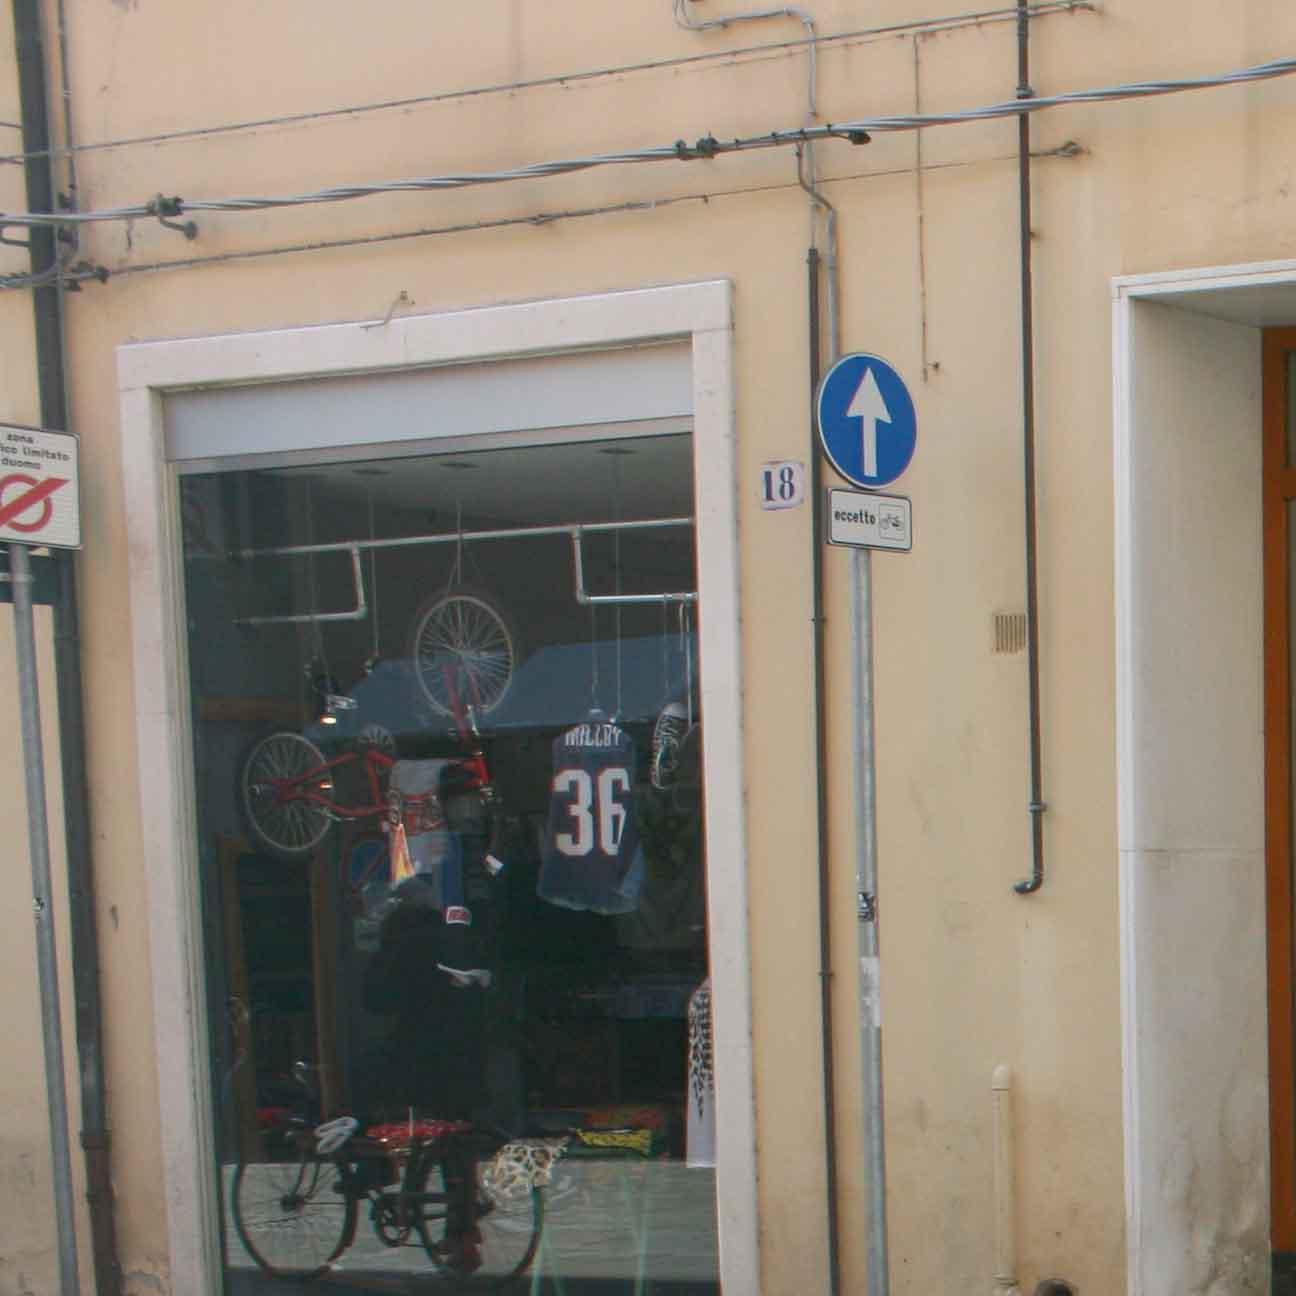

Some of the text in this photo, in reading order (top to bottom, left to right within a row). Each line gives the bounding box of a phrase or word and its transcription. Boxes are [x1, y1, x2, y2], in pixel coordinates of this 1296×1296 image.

[763, 466, 795, 501] 18
[834, 508, 876, 526] eccetto
[553, 767, 631, 857] 36
